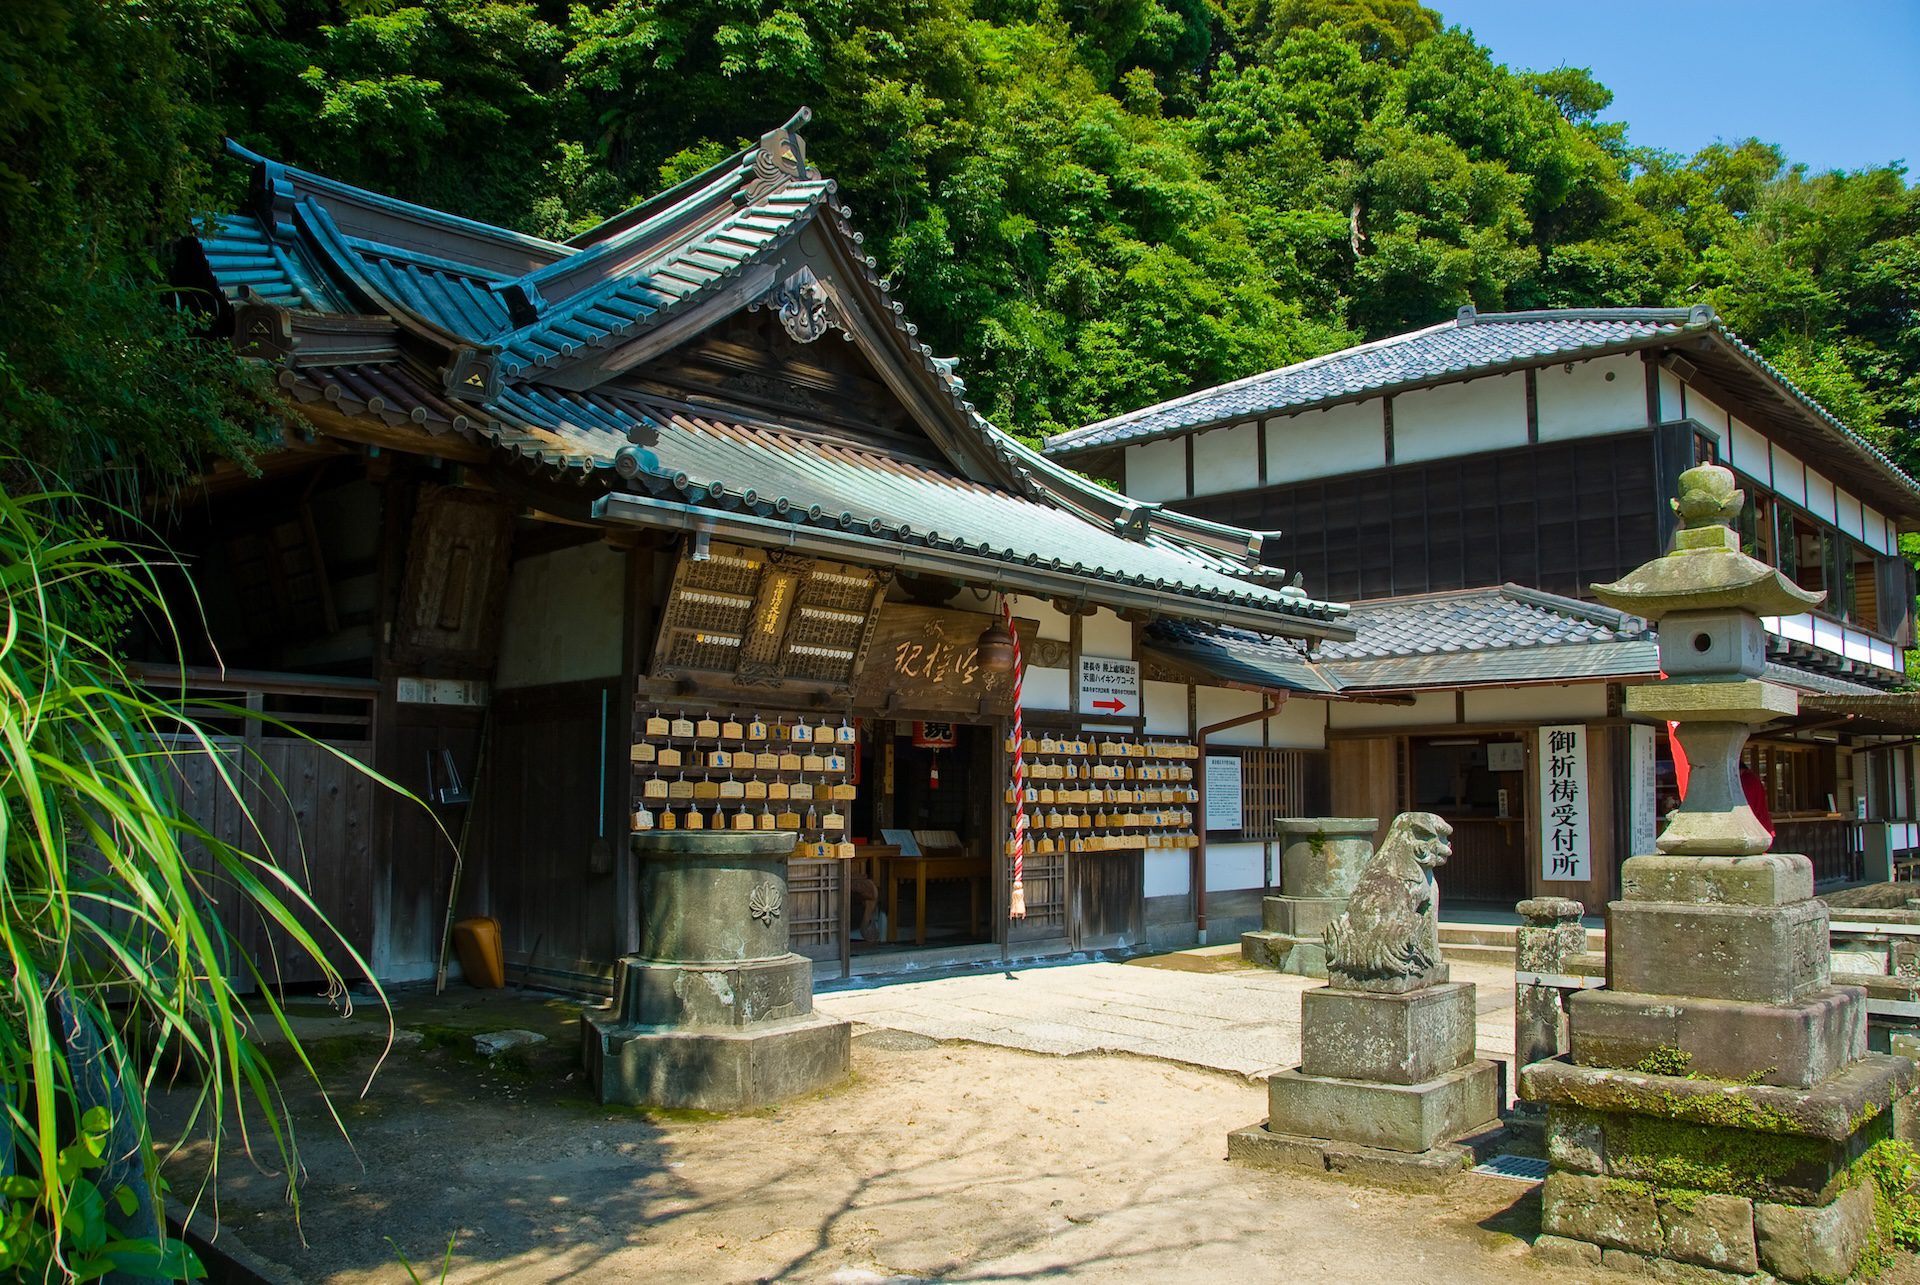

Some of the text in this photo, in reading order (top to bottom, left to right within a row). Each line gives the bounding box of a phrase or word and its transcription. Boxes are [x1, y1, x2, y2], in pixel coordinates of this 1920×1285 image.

[1083, 661, 1101, 672] 建長寺
[1083, 673, 1136, 685] 天園ハイキングコース
[1548, 730, 1580, 877] 御祈祷受付所
